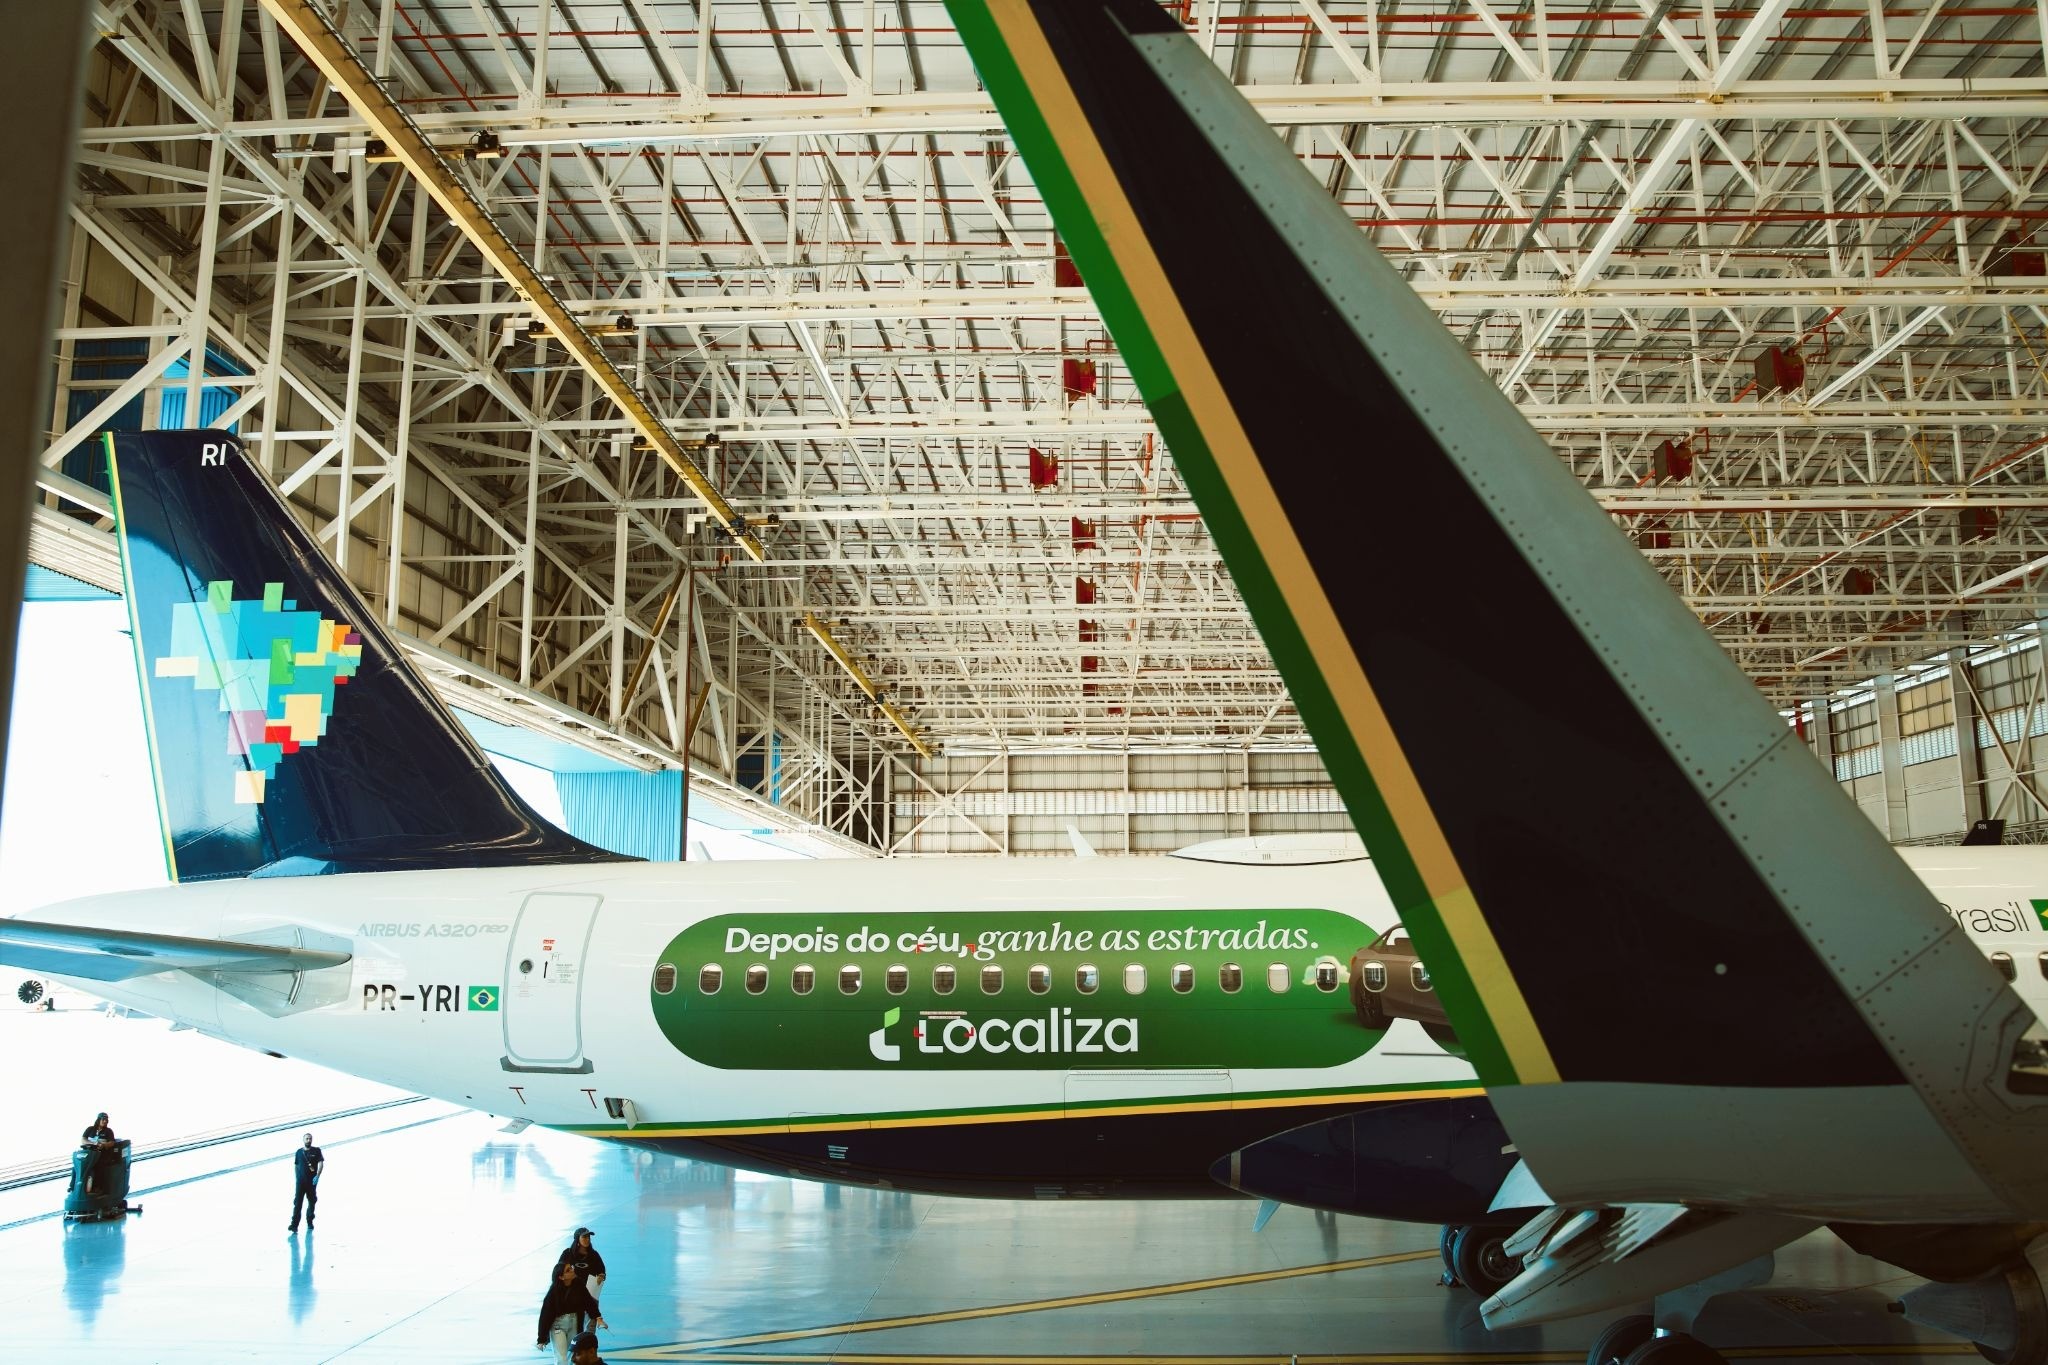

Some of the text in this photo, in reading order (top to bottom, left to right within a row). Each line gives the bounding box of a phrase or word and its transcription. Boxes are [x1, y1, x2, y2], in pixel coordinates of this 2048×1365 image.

[201, 443, 226, 466] RI
[357, 923, 421, 937] AIRBUS
[1940, 901, 2030, 933] rasil
[725, 919, 1319, 961] Depois do céu, ganhe as estradas.
[363, 984, 460, 1012] PR-YRI
[918, 1007, 1139, 1054] Localiza
